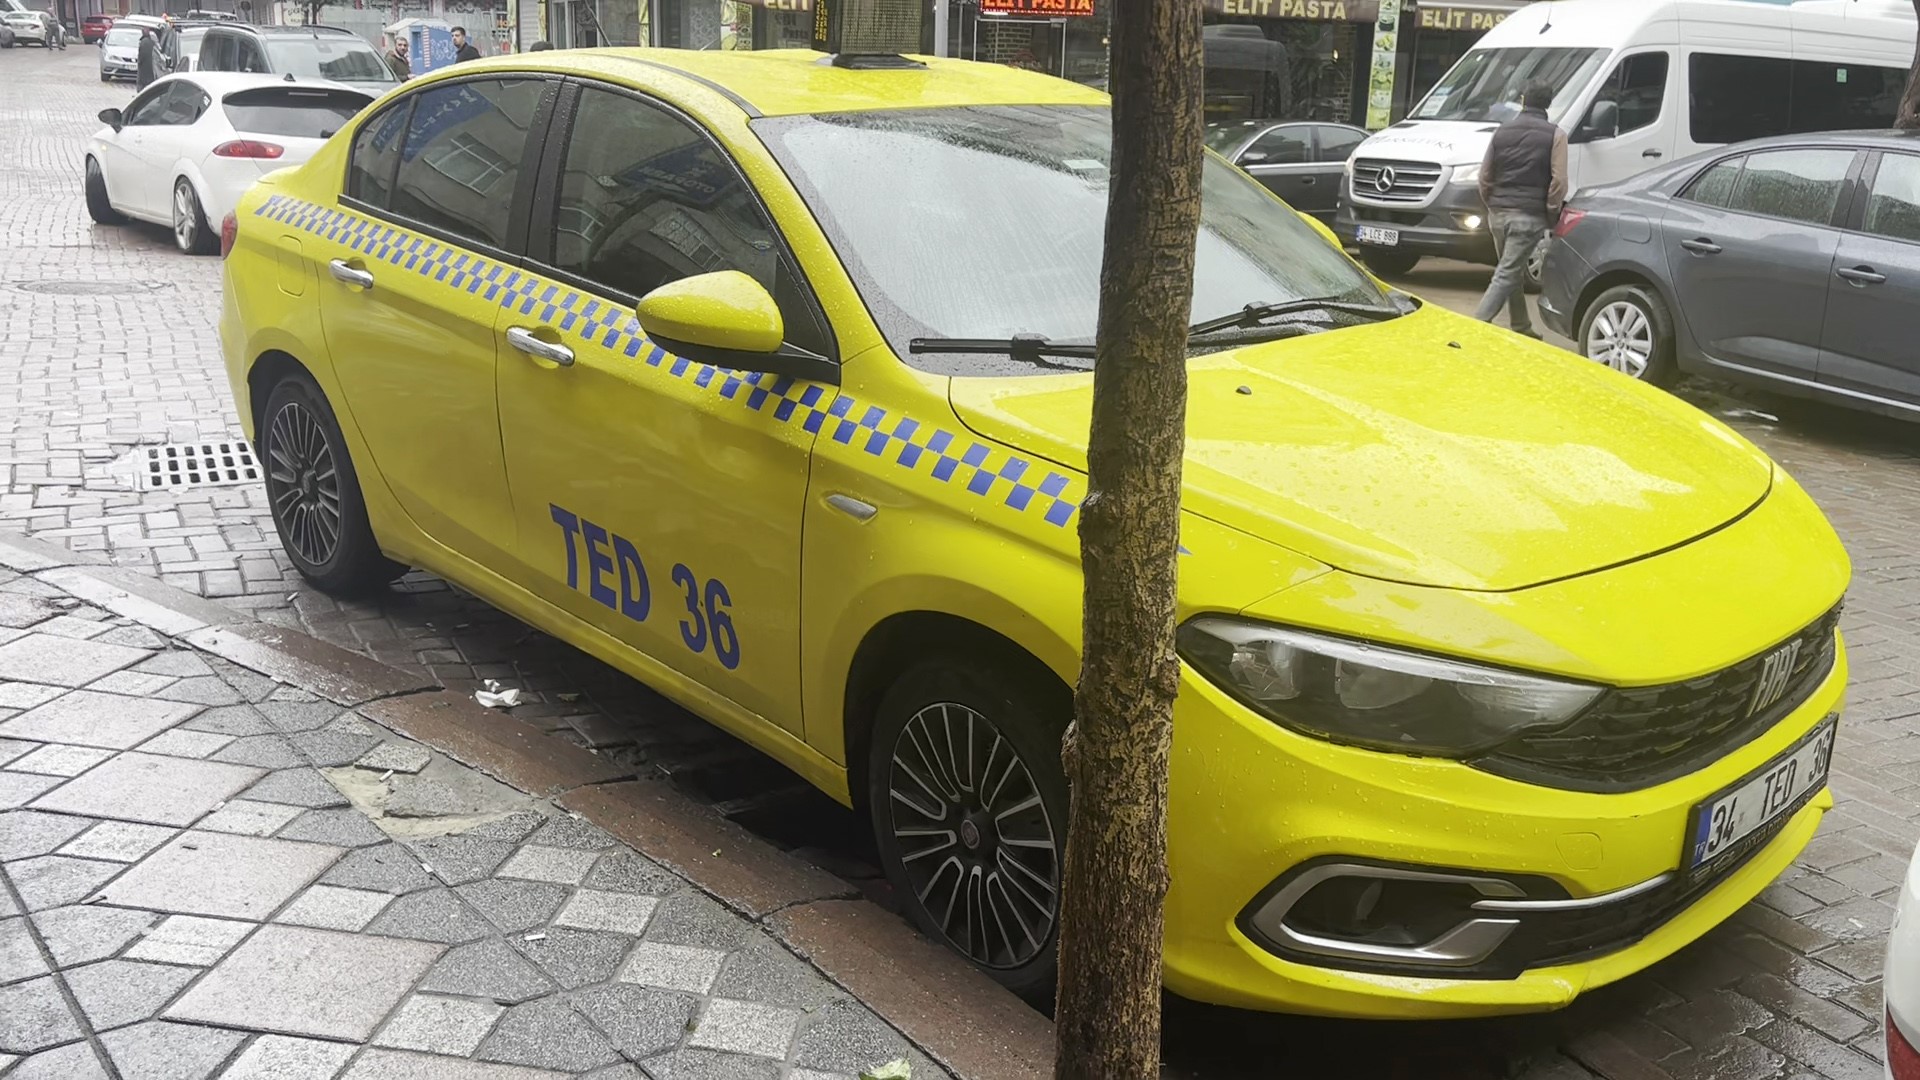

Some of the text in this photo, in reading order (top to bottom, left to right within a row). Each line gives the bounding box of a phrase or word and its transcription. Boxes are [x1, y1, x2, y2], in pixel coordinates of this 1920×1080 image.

[1280, 0, 1346, 20] PASTA
[1471, 12, 1505, 29] PAS
[549, 502, 740, 670] TED 36
[1746, 637, 1802, 718] FIAT
[1708, 796, 1737, 853] 34
[1761, 758, 1798, 820] TED
[1808, 730, 1830, 783] 36
